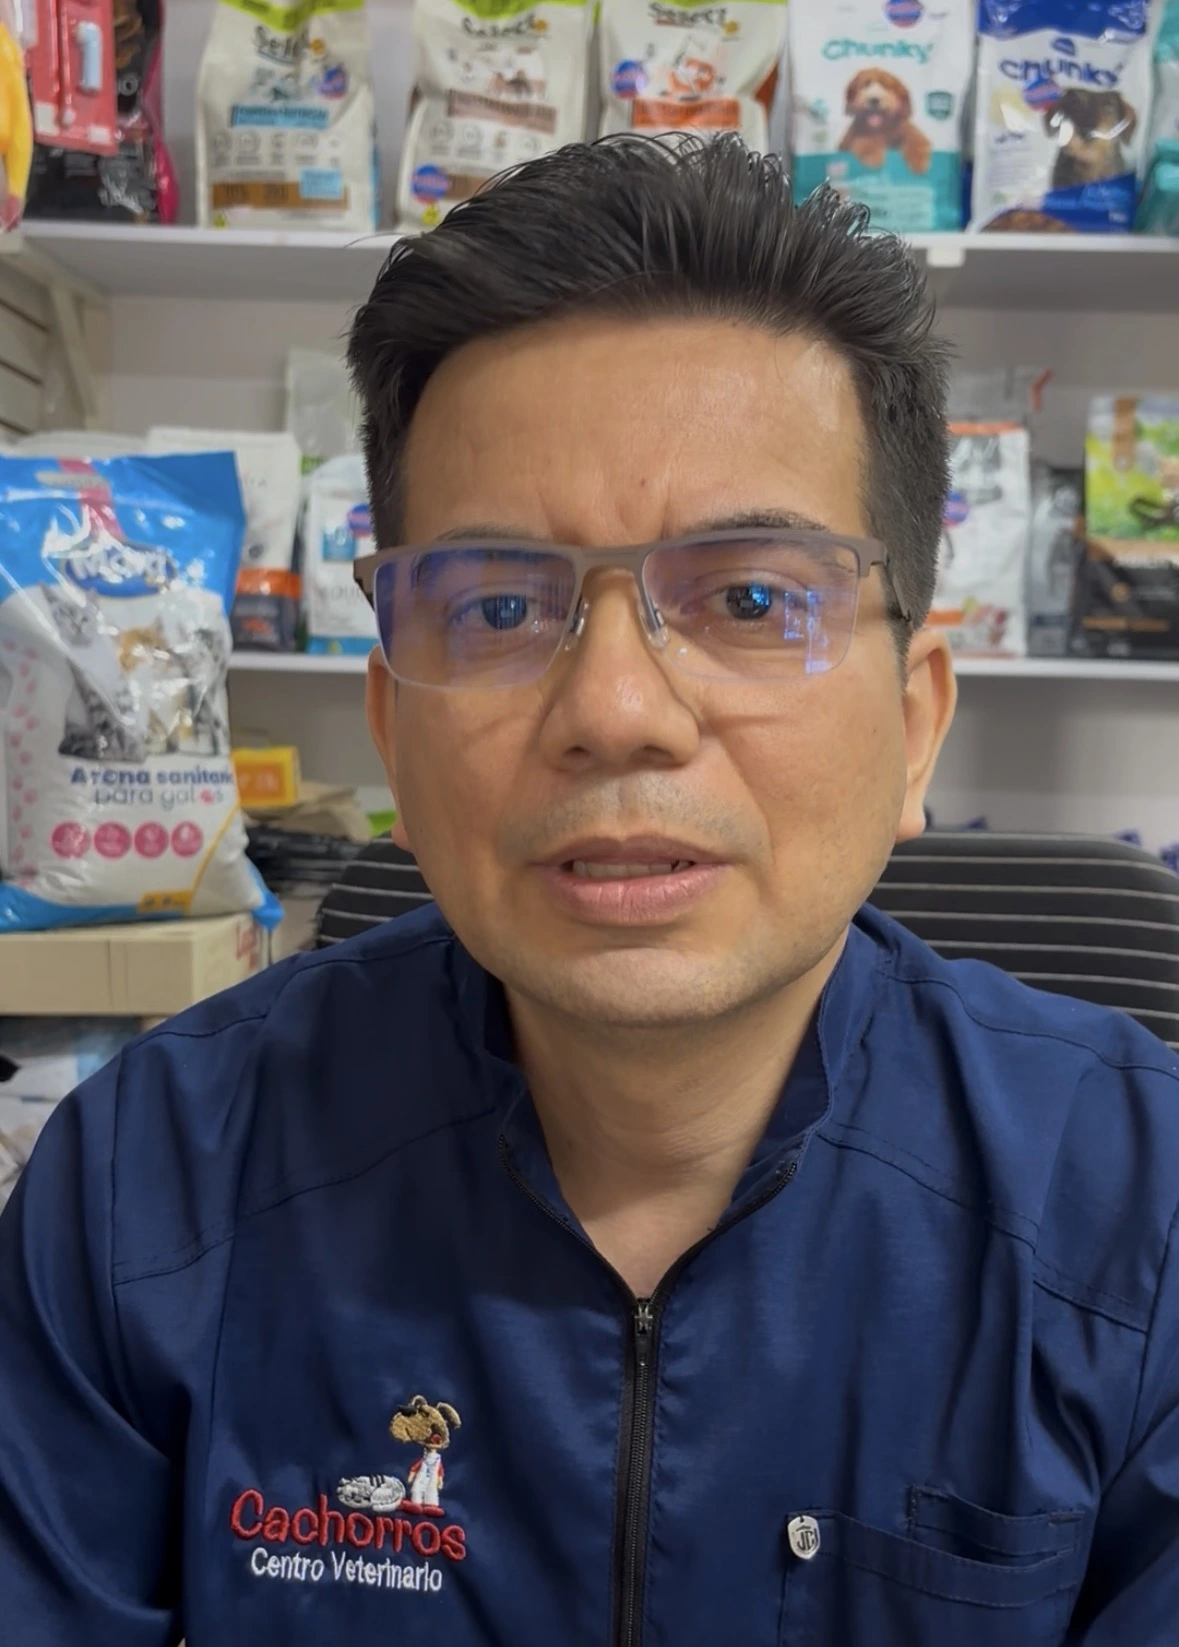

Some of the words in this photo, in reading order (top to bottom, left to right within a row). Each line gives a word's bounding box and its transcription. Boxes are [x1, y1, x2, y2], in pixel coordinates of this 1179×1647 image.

[822, 39, 931, 64] Chunky
[94, 786, 154, 806] para
[230, 1488, 467, 1561] Cachorros
[250, 1545, 325, 1583] Centro
[331, 1550, 444, 1593] Veterinario
